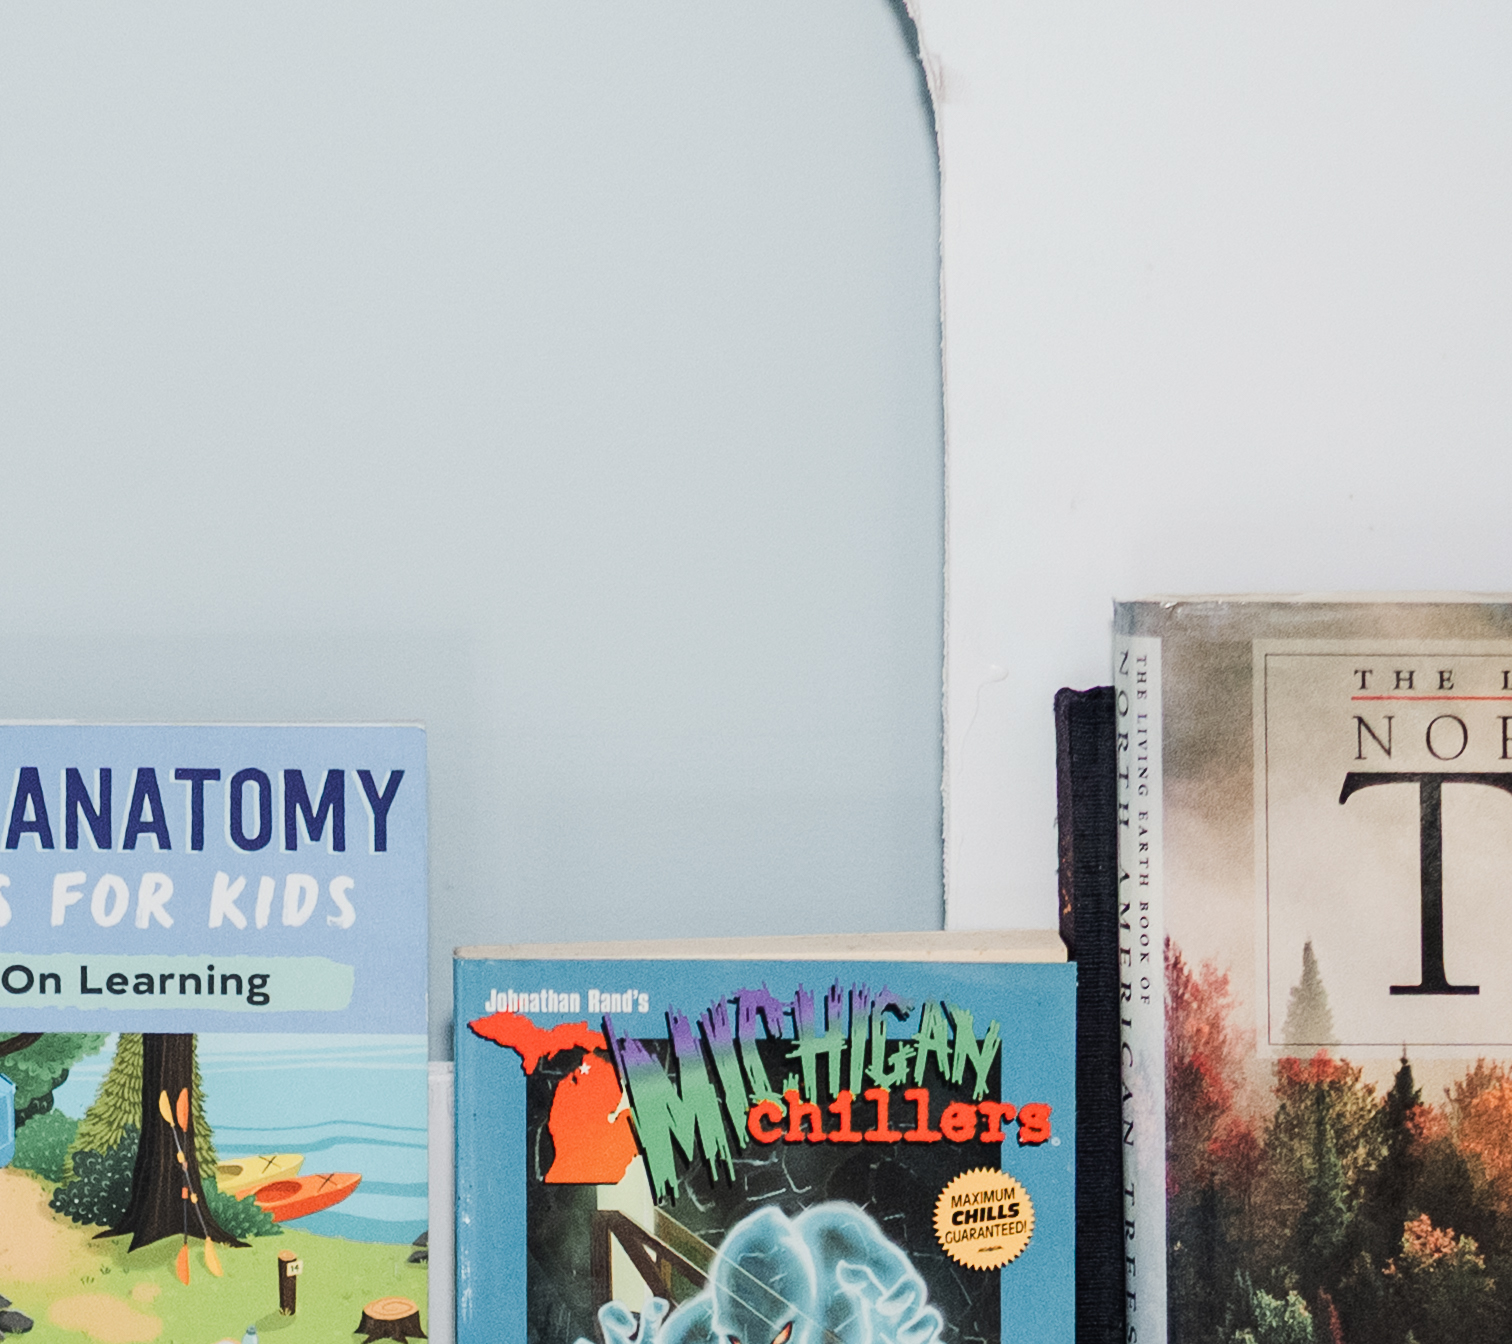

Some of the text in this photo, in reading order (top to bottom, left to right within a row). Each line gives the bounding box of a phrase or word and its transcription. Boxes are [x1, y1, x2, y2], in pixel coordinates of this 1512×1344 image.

[1355, 669, 1455, 694] THE
[5, 767, 406, 853] ANATOMY
[1137, 655, 1151, 1005] THE LIVING EARTH BOOK OF
[50, 872, 174, 929] FOR
[207, 874, 357, 929] KIDS
[80, 965, 271, 1006] Learning
[485, 987, 650, 1014] Johnathan Rand's
[1116, 649, 1139, 1344] NORTH AMERICAN TREES
[602, 976, 1003, 1205] MICHIGAN
[748, 1087, 1053, 1149] chillers
[951, 1187, 1016, 1209] MAXIMUM
[951, 1202, 1020, 1226] CHILLS
[945, 1220, 1027, 1244] GUARANTEED!
